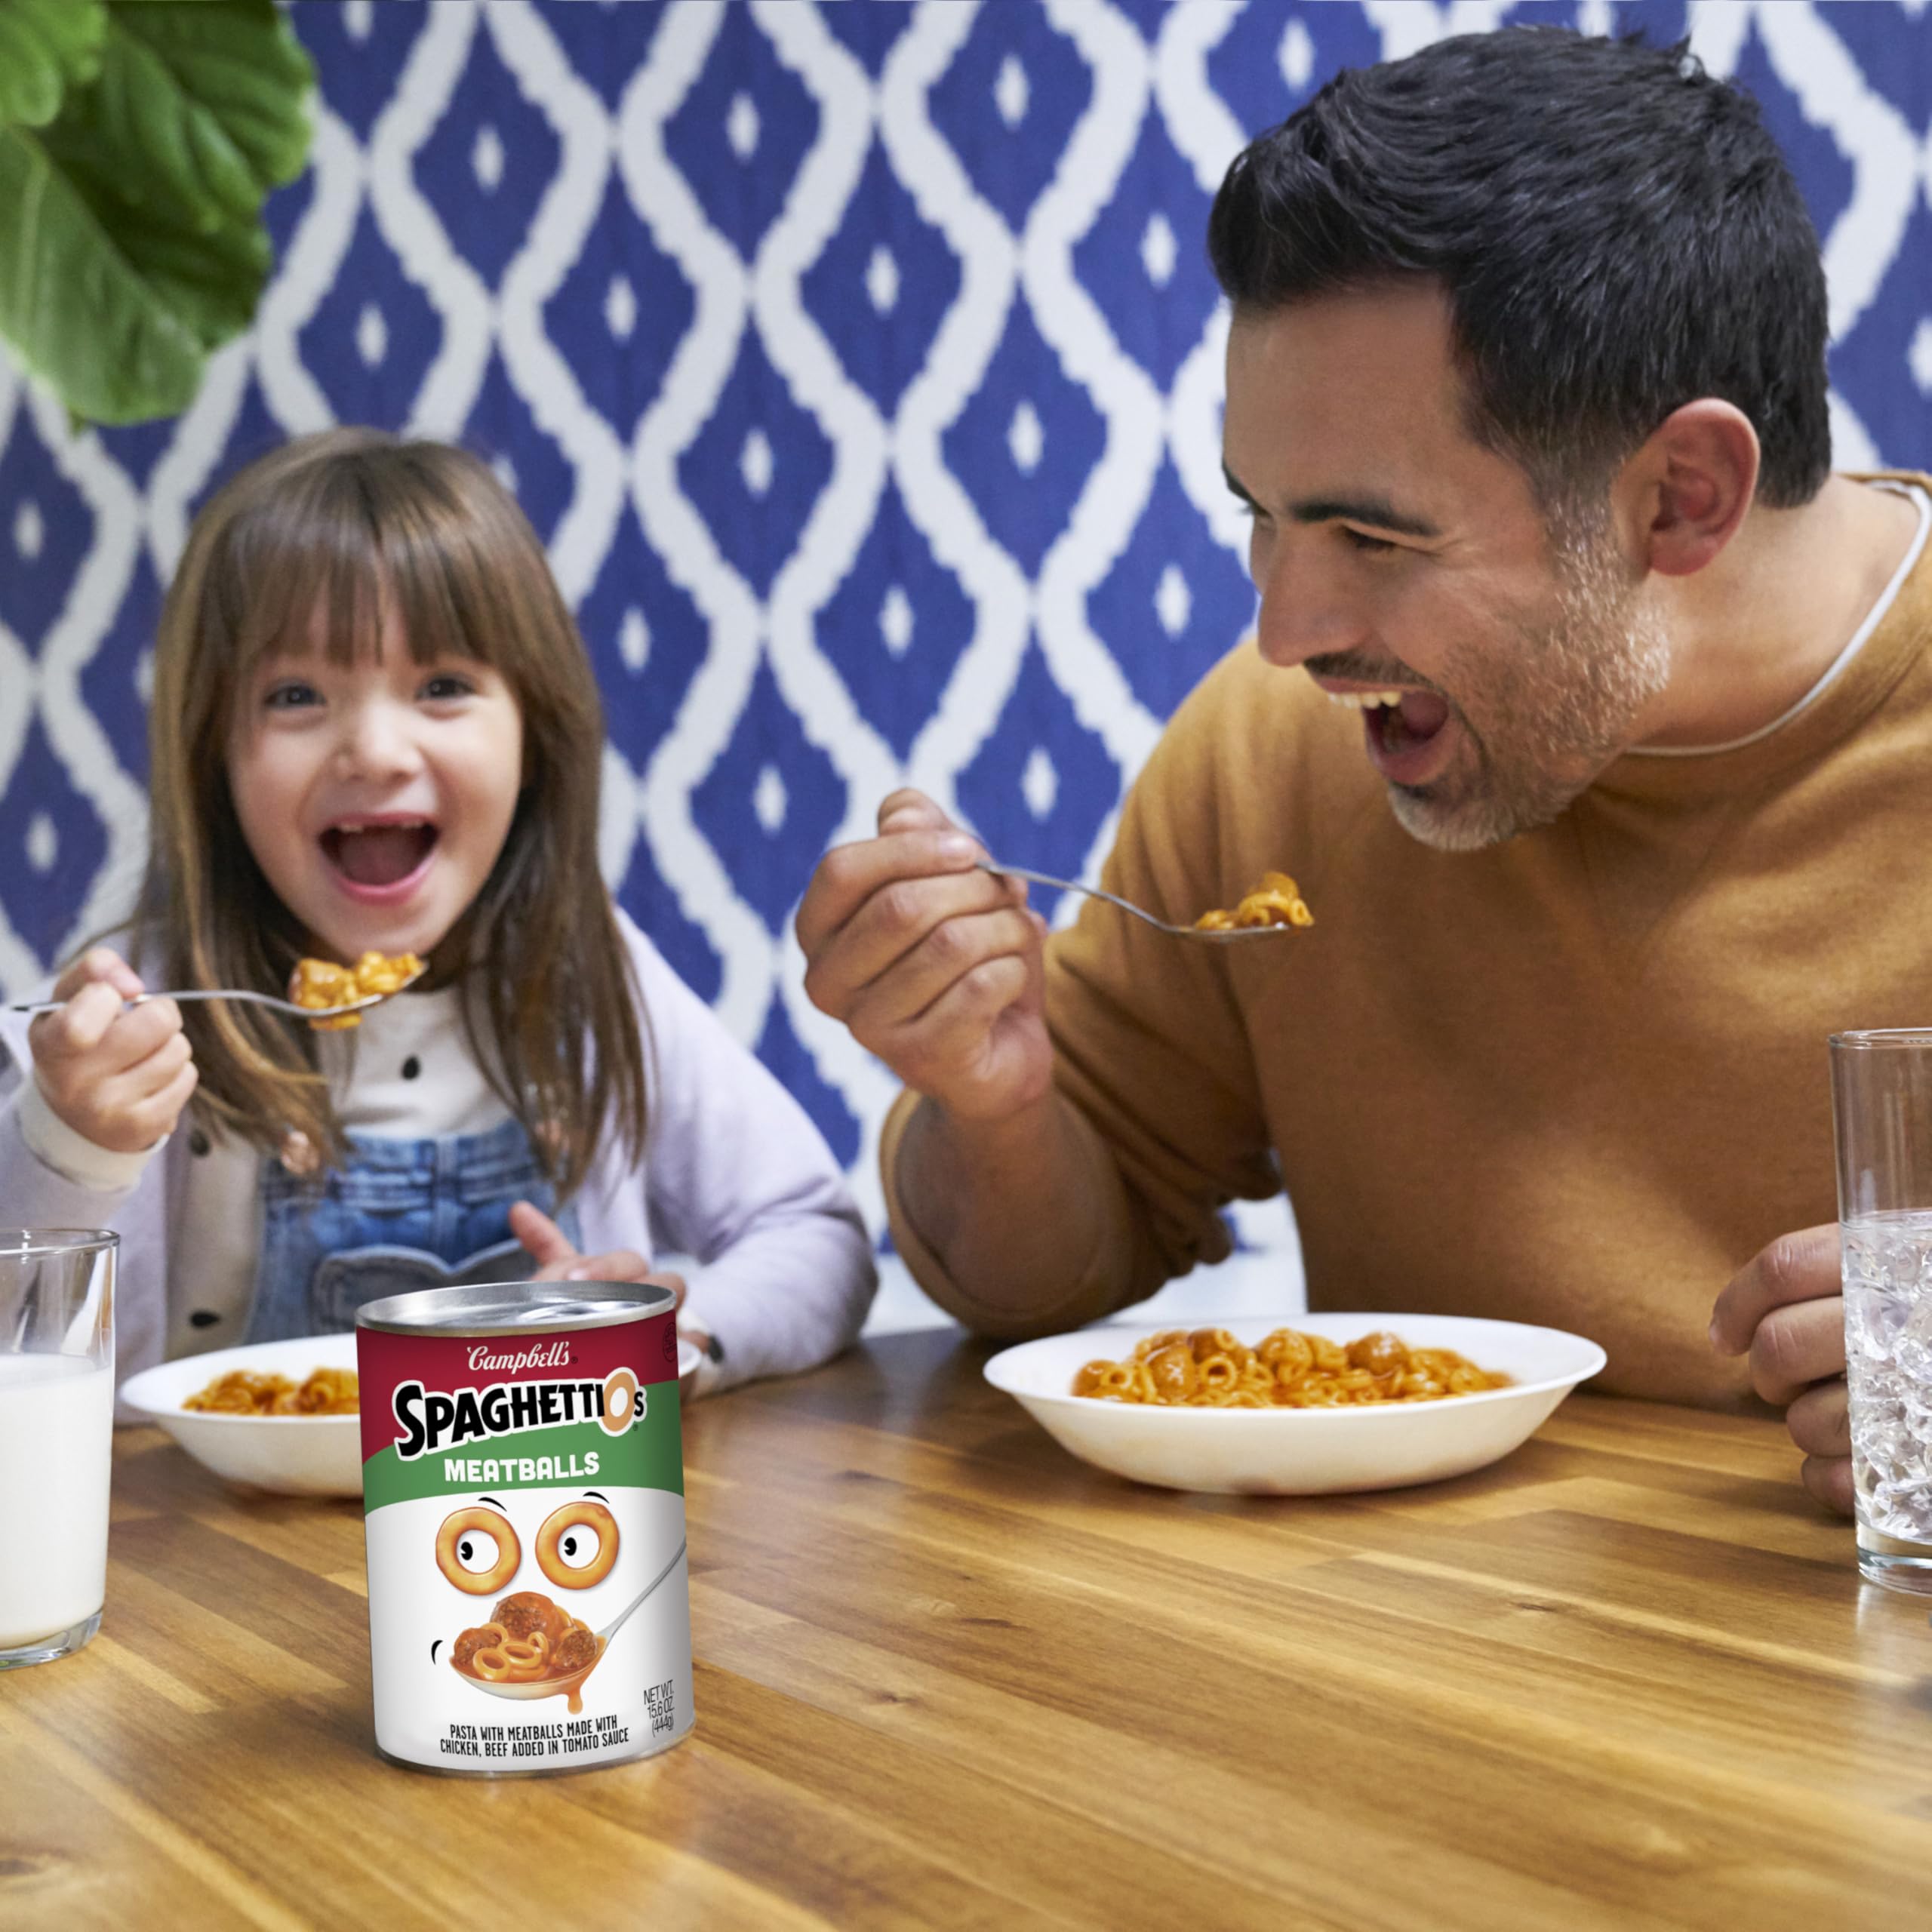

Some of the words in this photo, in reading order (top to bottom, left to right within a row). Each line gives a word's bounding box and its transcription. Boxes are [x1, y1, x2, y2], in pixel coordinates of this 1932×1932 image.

[467, 1342, 570, 1374] Campbell's
[444, 1452, 599, 1481] MEATBALLS
[644, 1685, 660, 1705] NET
[647, 1700, 663, 1719] 15.6
[450, 1724, 477, 1740] PASTA
[480, 1726, 503, 1741] WITH
[508, 1724, 563, 1741] MEATBALLS
[567, 1719, 592, 1737] MADE
[596, 1715, 617, 1732] WITH
[652, 1712, 674, 1738] (444g)
[440, 1739, 481, 1757] CHICKEN,
[485, 1742, 508, 1757] BEEF
[512, 1741, 544, 1757] ADDED
[548, 1740, 558, 1754] IN
[562, 1734, 598, 1753] TOMATO
[602, 1727, 629, 1747] SAUCE
